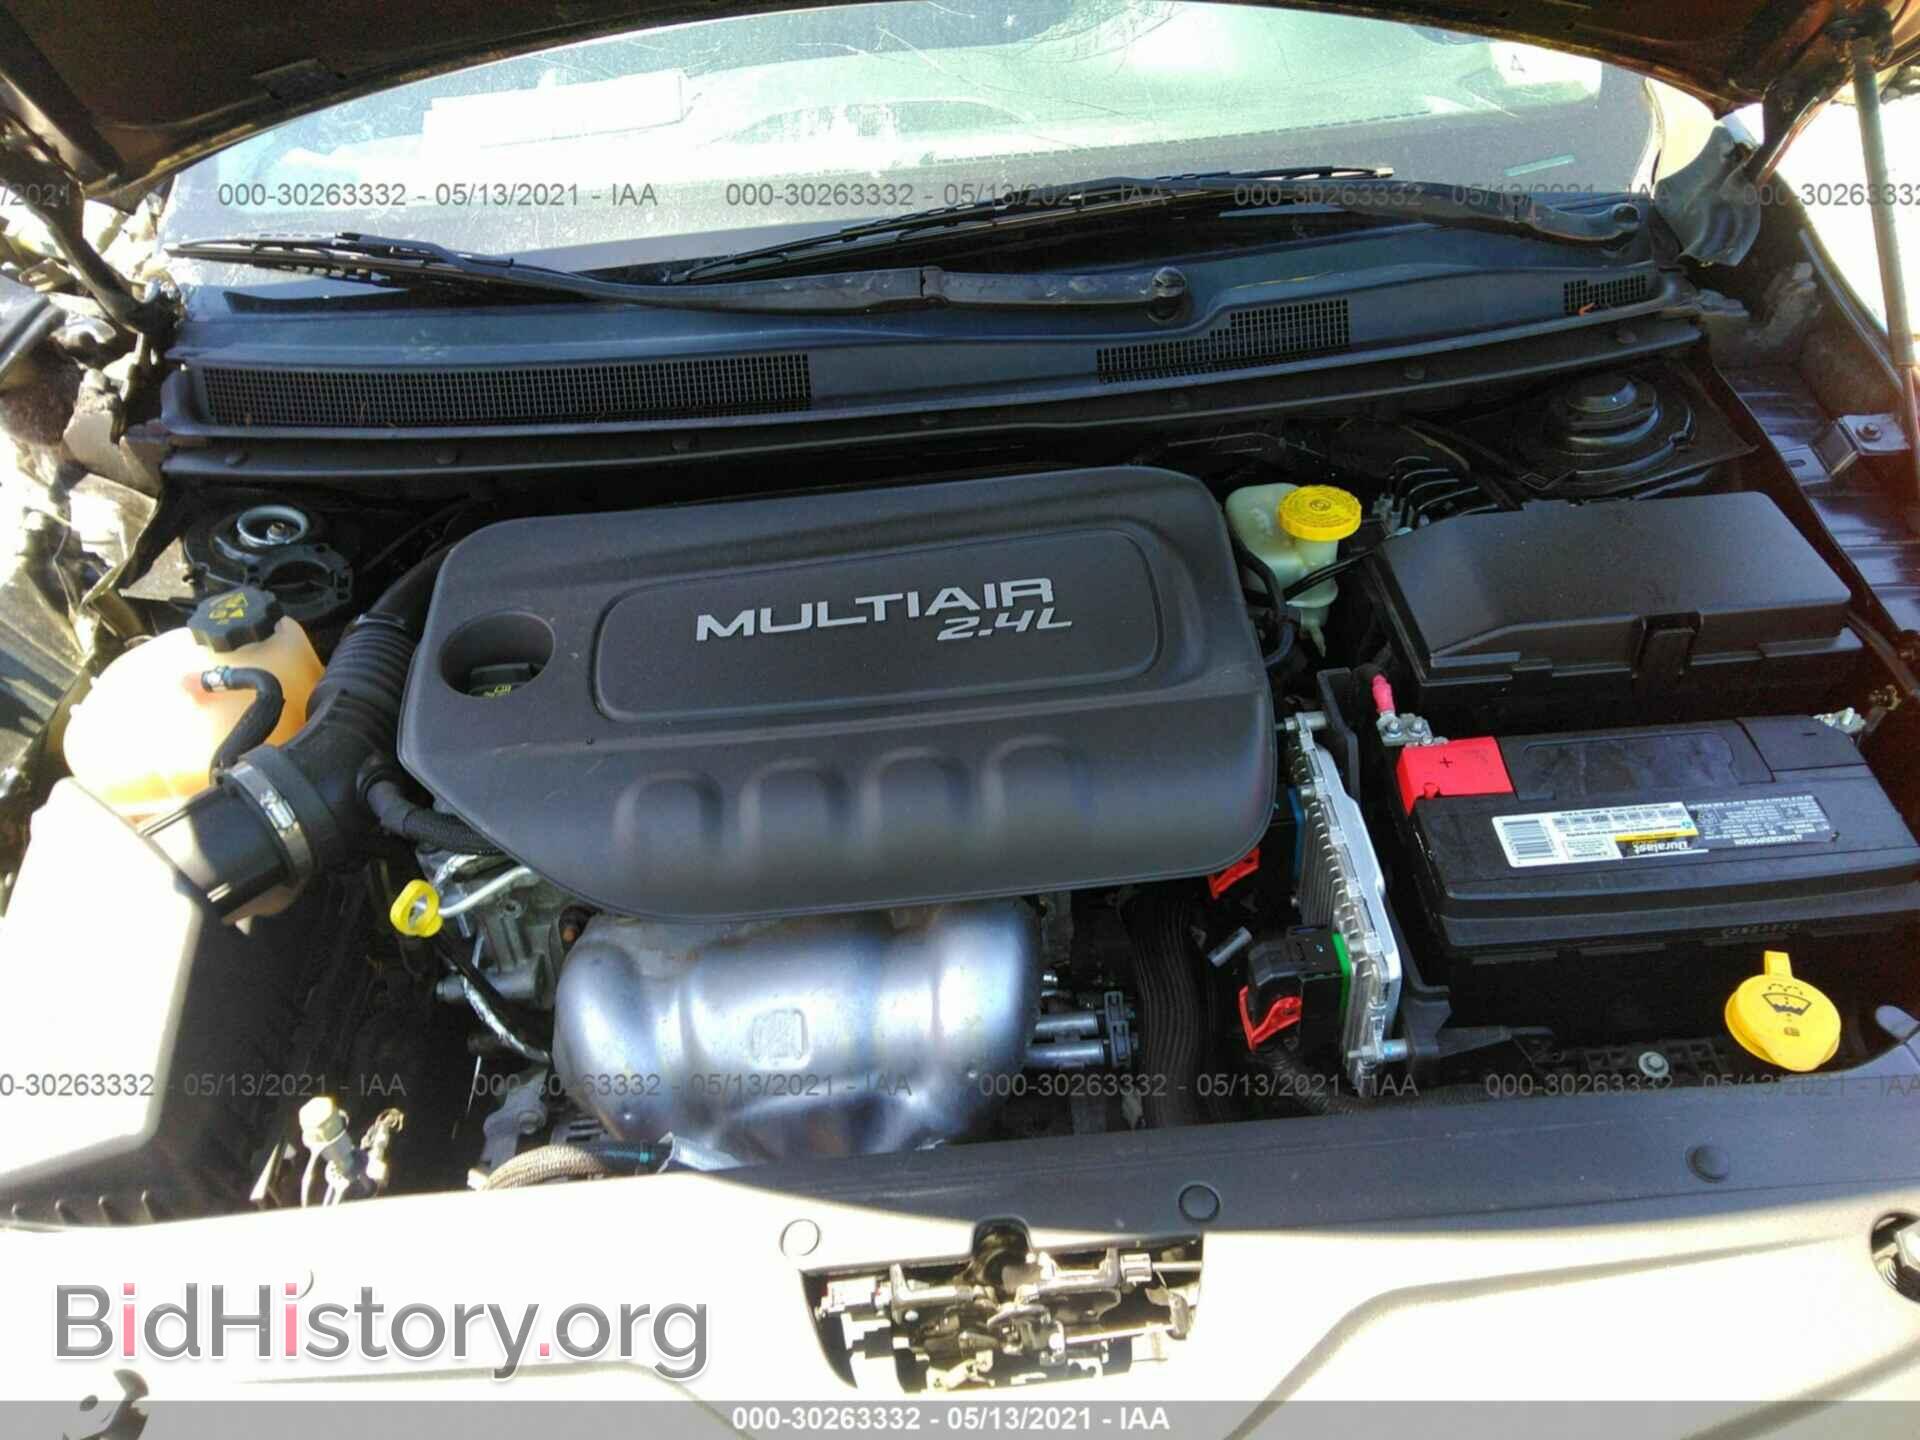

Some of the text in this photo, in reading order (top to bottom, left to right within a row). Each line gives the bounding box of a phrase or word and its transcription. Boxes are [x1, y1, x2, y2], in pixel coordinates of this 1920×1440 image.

[696, 577, 1055, 641] MULTIAIR
[937, 608, 1072, 640] 2.4L
[1632, 840, 1689, 855] Duralast
